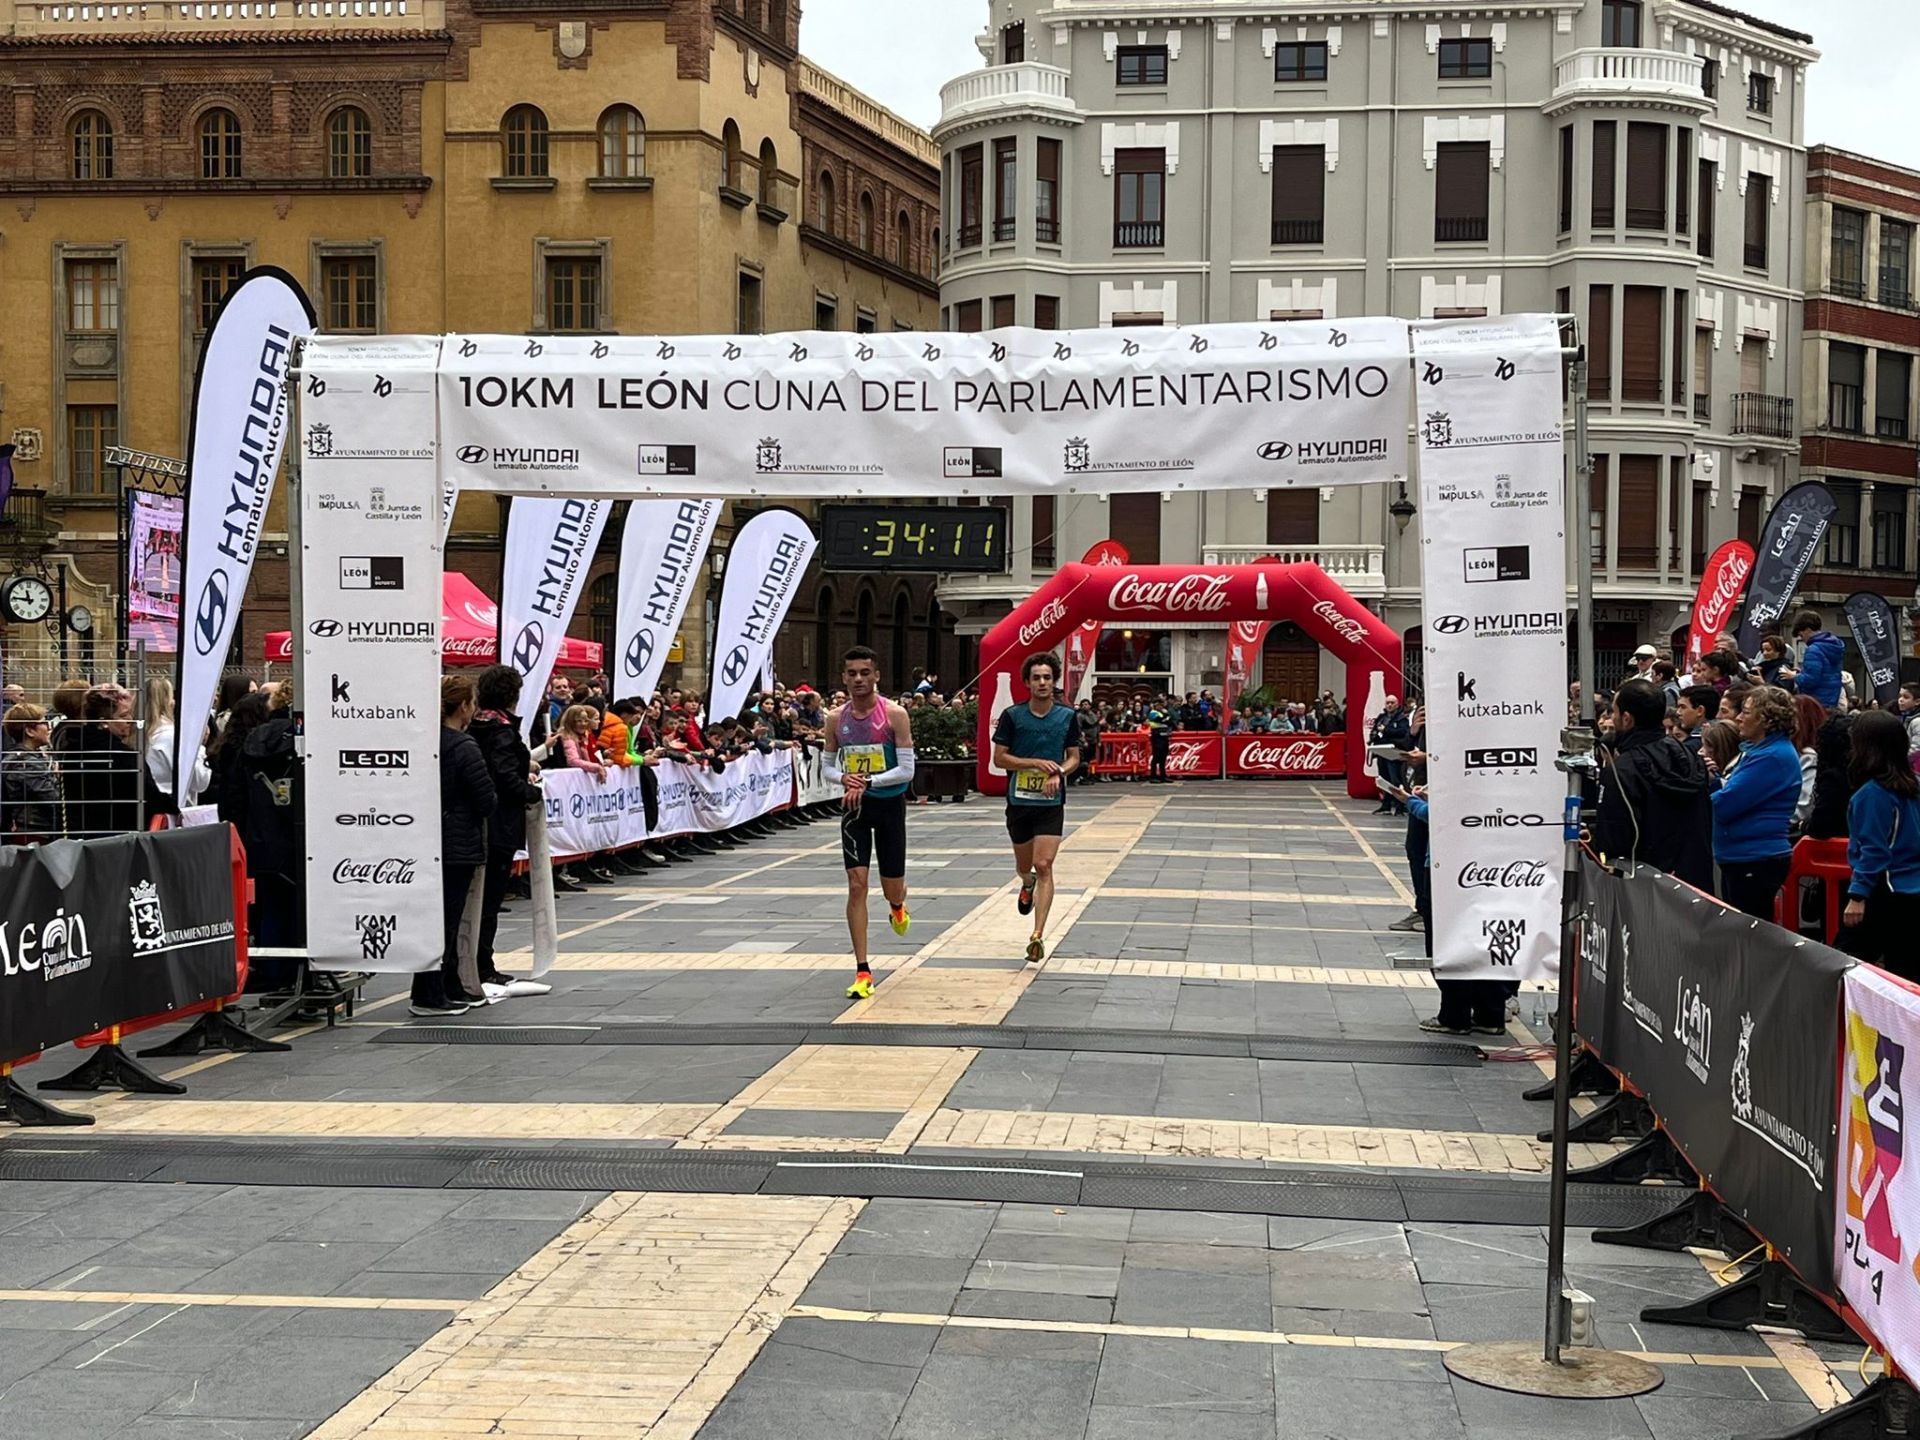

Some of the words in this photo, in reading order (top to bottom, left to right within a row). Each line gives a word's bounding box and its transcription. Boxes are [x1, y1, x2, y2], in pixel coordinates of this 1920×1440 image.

[459, 376, 574, 409] 10KM
[599, 370, 708, 410] LEÓN
[724, 380, 847, 412] CUNA
[862, 380, 939, 412] DEL
[954, 365, 1388, 412] PARLAMENTARISMO
[217, 324, 289, 560] HYUNDAI
[1455, 434, 1523, 445] AYUNTAMIENTO
[1525, 433, 1536, 441] DE
[1538, 431, 1561, 440] LEÓN
[412, 447, 434, 456] LEÓN
[494, 447, 579, 463] HYUNDAI
[1298, 439, 1387, 458] HYUNDAI
[642, 453, 665, 463] LEÓN
[947, 456, 970, 466] LEÓN
[1091, 460, 1157, 470] AYUNTAMIENTO
[1158, 460, 1170, 468] DE
[1174, 457, 1194, 468] LEÓN
[1298, 456, 1335, 465] Lemauto
[1337, 452, 1387, 463] Automoción
[494, 463, 528, 471] Lemauto
[529, 462, 579, 471] Automoción
[862, 463, 884, 472] LEÓN
[1513, 491, 1536, 499] Junta
[1537, 490, 1548, 498] de
[386, 504, 410, 512] Junta
[411, 504, 422, 512] de
[1490, 500, 1520, 509] Castilla
[1528, 498, 1549, 508] León
[237, 472, 269, 565] Lemauto
[365, 512, 394, 520] Castilla
[402, 512, 422, 520] León
[531, 499, 586, 615] HYUND
[552, 559, 580, 619] Lemauto
[573, 499, 600, 557] Automo
[661, 575, 686, 627] Lemauto
[682, 501, 713, 573] Automoción
[1468, 558, 1495, 570] LEÓN
[344, 566, 369, 577] LEÓN
[740, 533, 799, 641] HYUNDAI
[756, 601, 781, 645] Lemauto
[776, 540, 808, 601] Automoción
[1108, 573, 1234, 612] Coca-Cola
[1019, 596, 1067, 646] Coca-Cola
[1312, 600, 1371, 644] Coca-Cola
[1474, 612, 1563, 630] HYUNDAI
[348, 622, 435, 636] HYUNDAI
[1474, 629, 1509, 638] Lemauto
[1511, 627, 1563, 636] Automoción
[331, 705, 416, 719] kutxabank
[1458, 701, 1544, 718] kutxabank
[342, 753, 407, 766] LEON
[1239, 740, 1329, 770] Coca-Cola
[1467, 751, 1536, 766] LEON
[1465, 768, 1538, 776] PLAZA
[1026, 776, 1044, 790] 137
[335, 807, 415, 826] emico
[1461, 808, 1544, 827] emico
[332, 858, 417, 884] Coca-Cola
[1458, 861, 1548, 888] Coca-Cola
